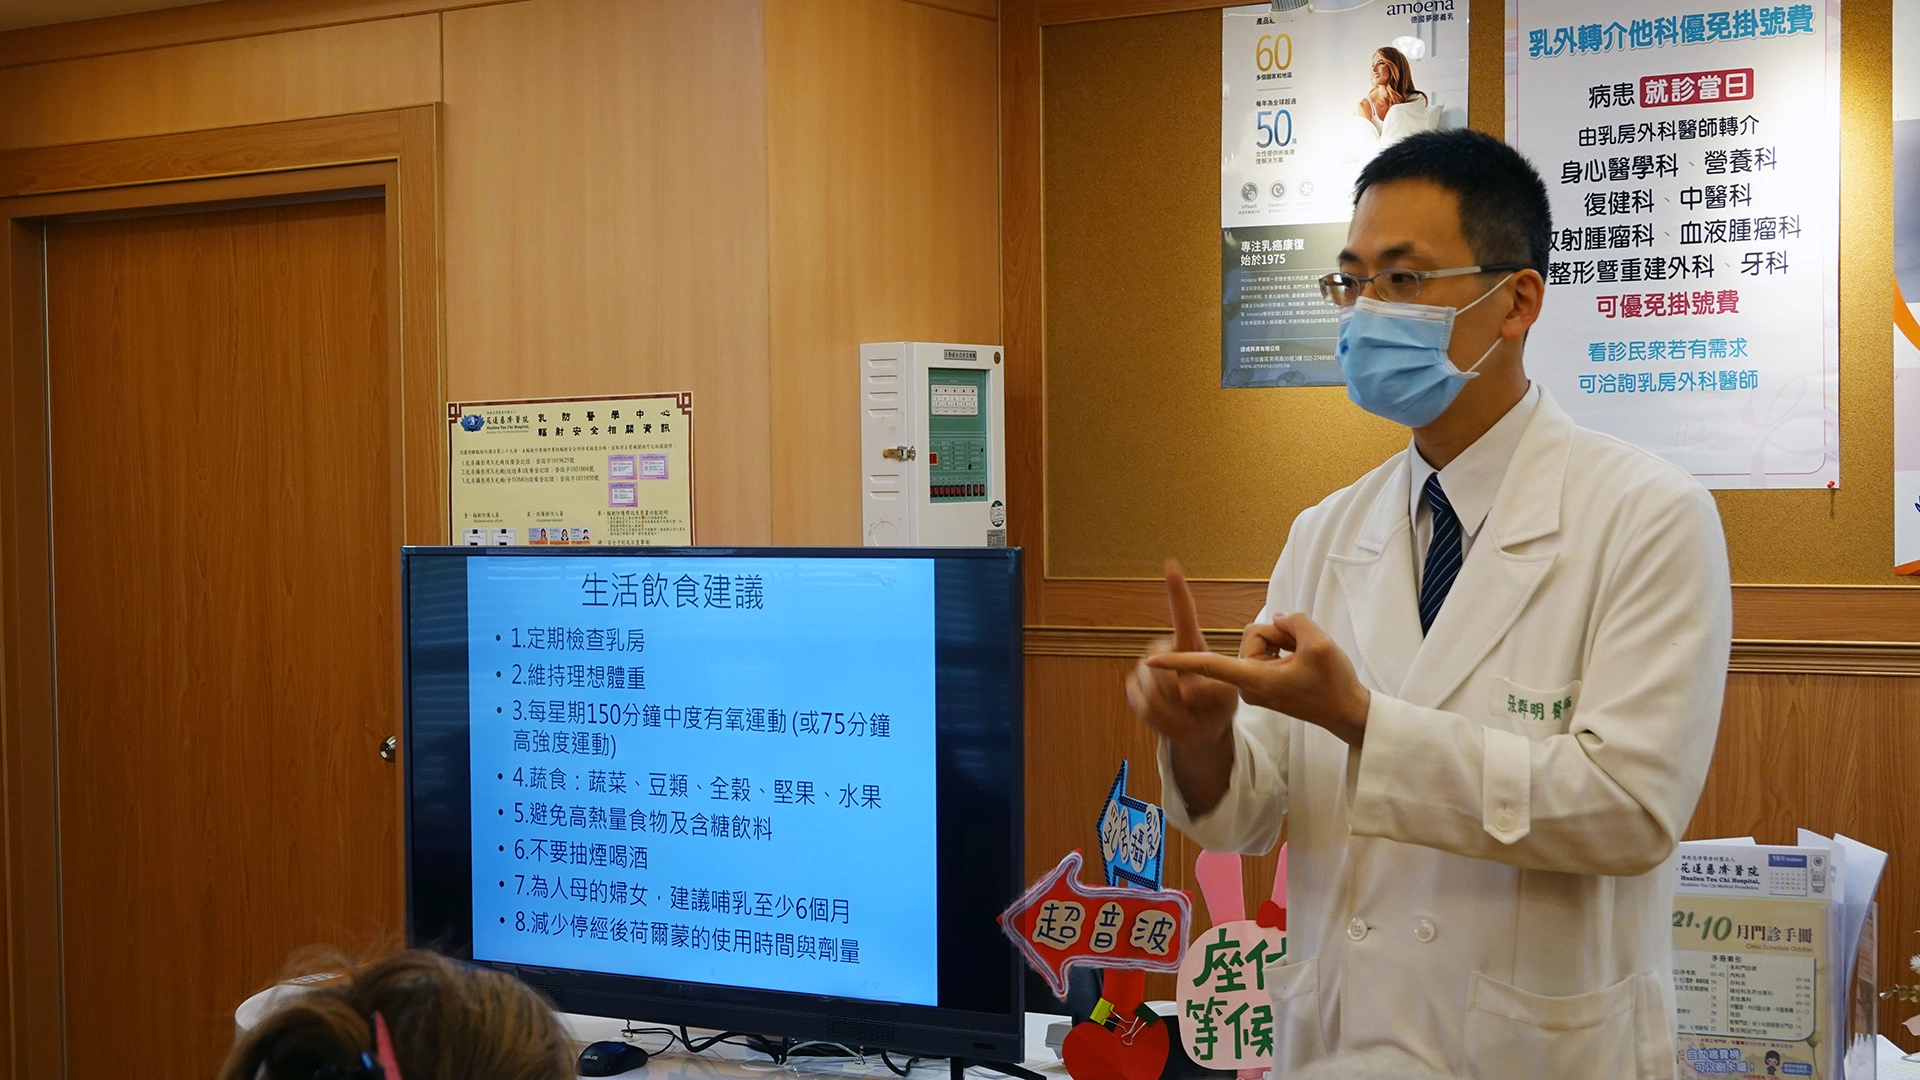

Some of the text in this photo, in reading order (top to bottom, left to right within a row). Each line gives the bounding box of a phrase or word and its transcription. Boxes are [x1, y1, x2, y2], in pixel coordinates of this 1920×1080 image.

[1386, 0, 1455, 16] amoena
[1528, 4, 1815, 58] 乳外轉介他科優免掛號費
[1256, 33, 1293, 72] 60
[1588, 72, 1748, 110] 病患 就診當日
[1578, 114, 1760, 147] 由乳房外科醫師轉介
[1560, 146, 1777, 185] 身心醫學科、營養科
[1584, 183, 1753, 217] 復健科、中醫科
[1240, 238, 1305, 253] 專注乳癌康復
[1240, 253, 1286, 266] 始於1975
[1596, 289, 1739, 318] 可優免掛號費
[1578, 369, 1759, 394] 可洽詢乳房外科醫師
[582, 572, 764, 610] 生活飲食建議
[511, 626, 645, 654] 1.定期檢查乳房
[511, 663, 646, 690] 2.維持理想體重
[513, 729, 617, 759] 高強度運動)
[514, 802, 773, 841] 5.避免高熱量食物及含糖飲料
[514, 838, 648, 870] 6.不要抽煙喝酒
[1680, 862, 1760, 877] 花蓮慈濟醫院
[515, 910, 861, 965] 8.減少停經後荷爾蒙的使用時間與劑量
[1037, 903, 1172, 953] 超音波
[1736, 924, 1813, 944] 月門診手冊
[1186, 996, 1274, 1060] 等候
